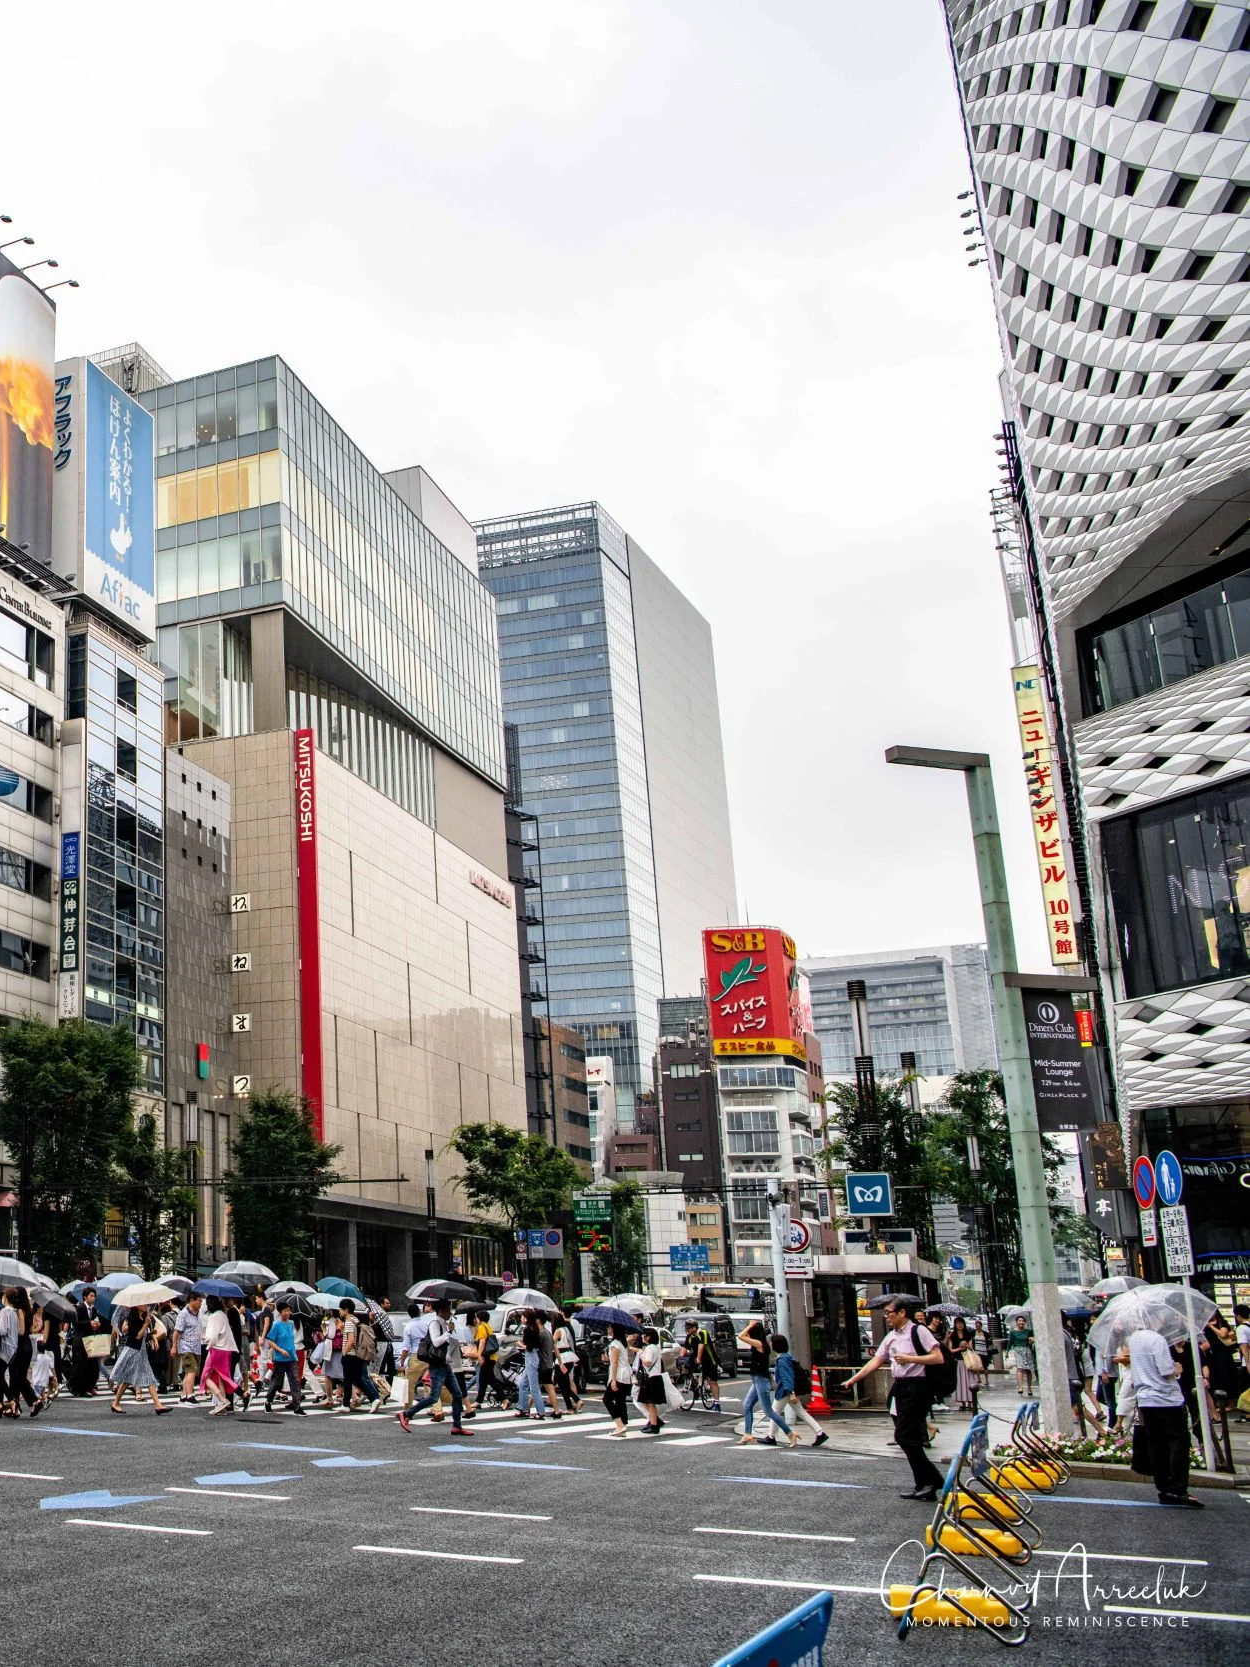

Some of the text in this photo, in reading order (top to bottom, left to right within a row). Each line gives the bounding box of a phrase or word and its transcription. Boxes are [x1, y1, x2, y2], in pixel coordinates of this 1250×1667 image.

[54, 375, 72, 471] アフラック
[109, 395, 122, 507] ほけん案内
[298, 736, 313, 842] MITSUKOSHI
[63, 899, 77, 951] 伸芽会
[710, 931, 766, 953] S&B
[720, 995, 767, 1016] スパイス
[742, 1011, 753, 1021] &
[1028, 1022, 1075, 1033] Diners Club
[1029, 1032, 1076, 1040] INTERNATIONAL
[719, 1040, 776, 1052] エスビー食品
[1034, 1059, 1081, 1068] Mid-Summer
[1045, 1067, 1073, 1077] Lounge
[782, 1257, 811, 1265] 2:00-1:00
